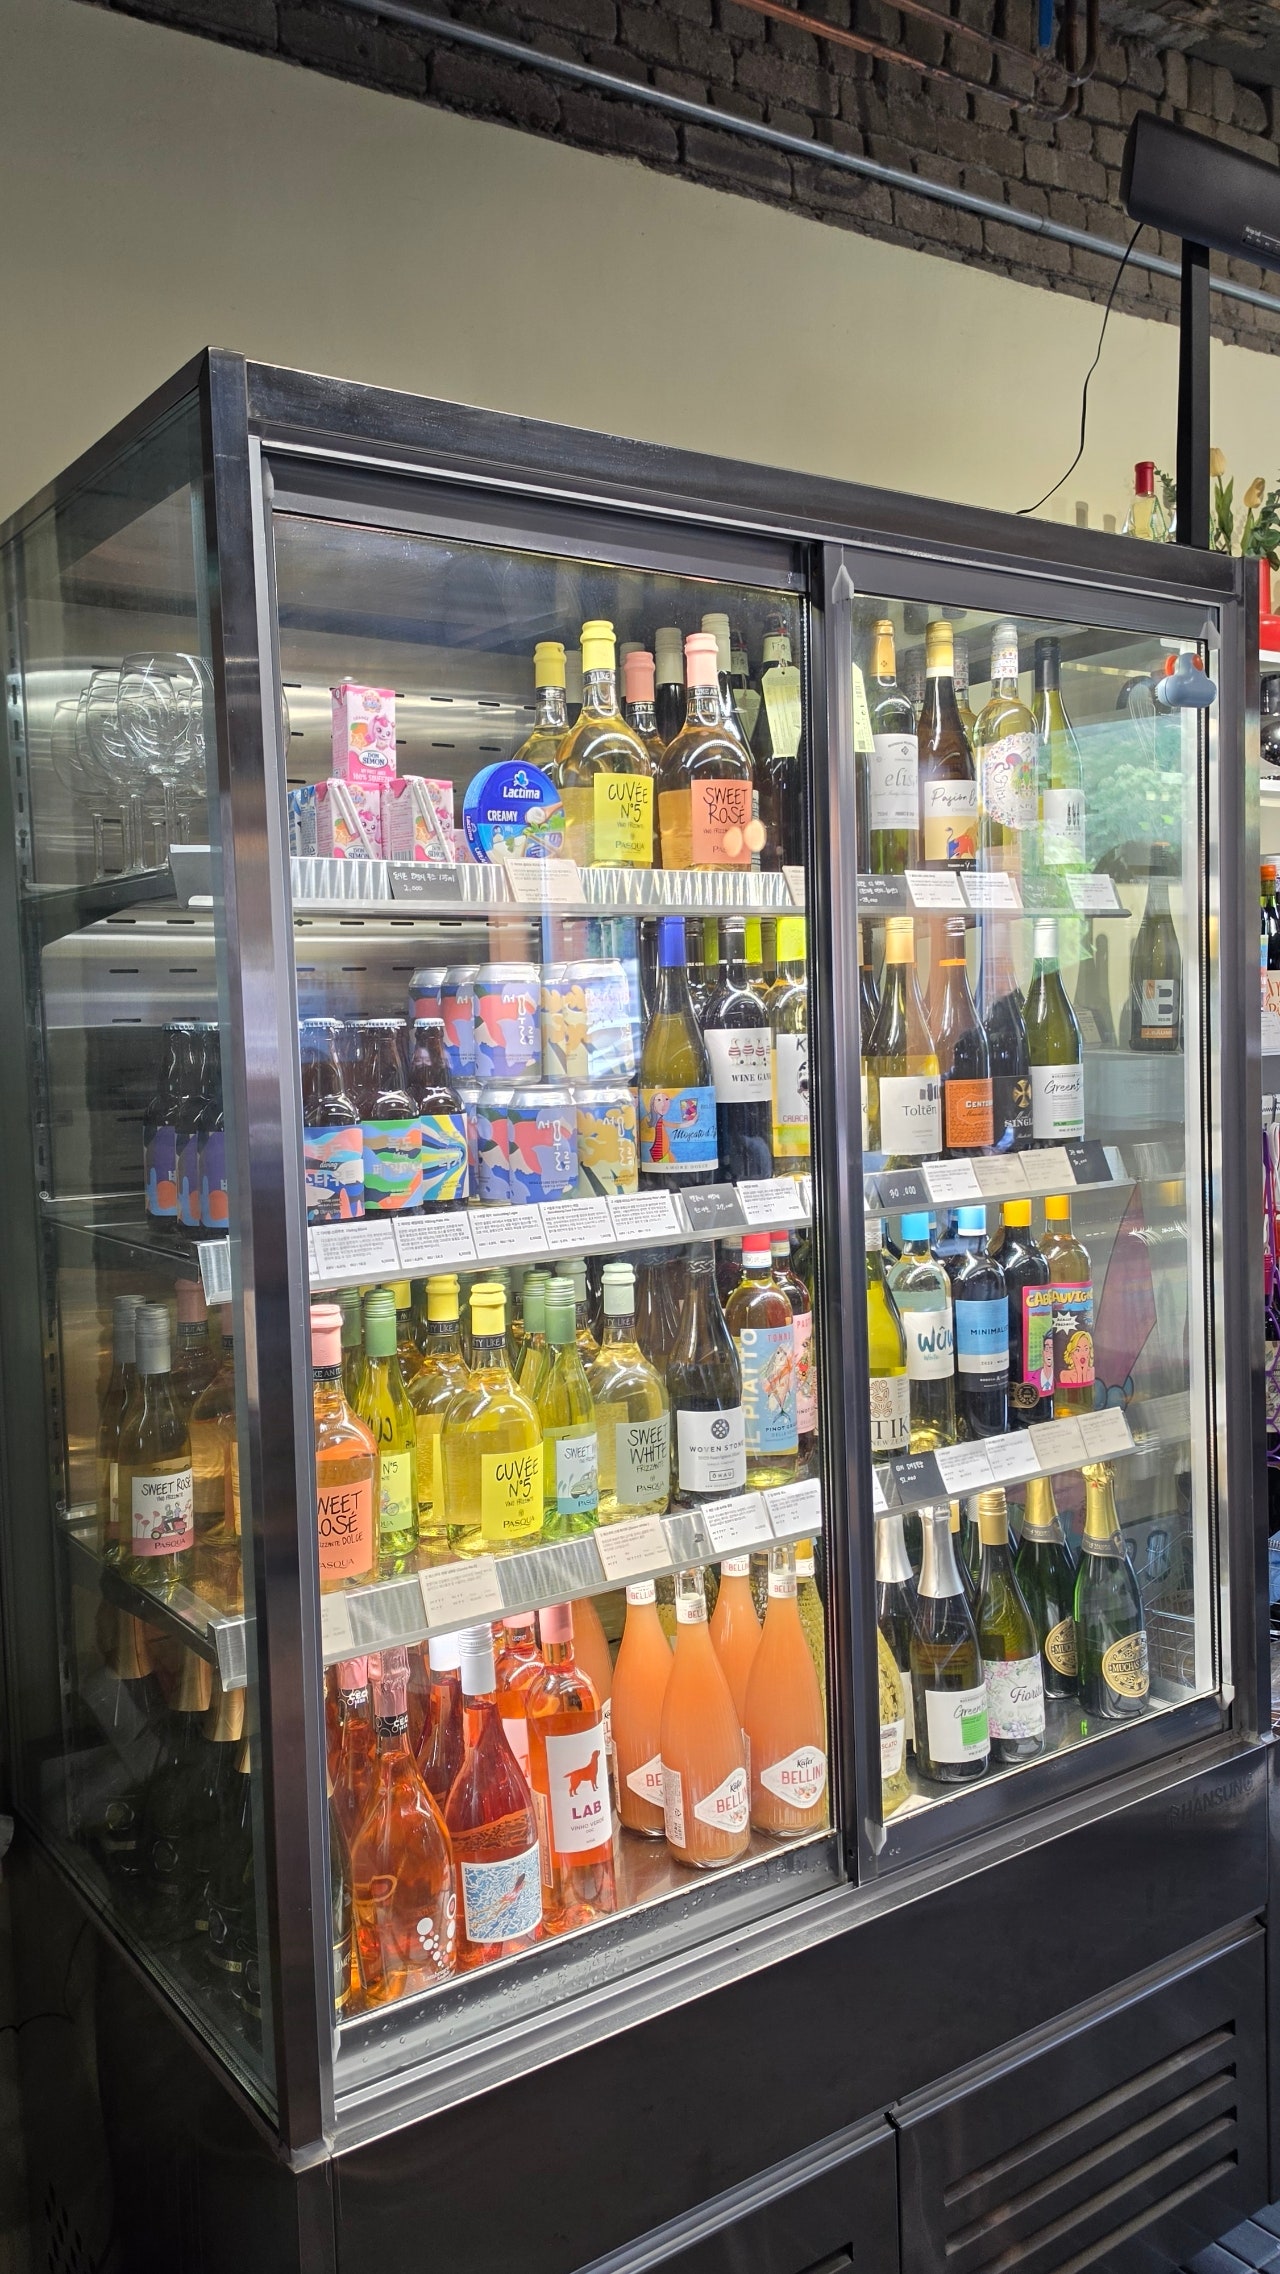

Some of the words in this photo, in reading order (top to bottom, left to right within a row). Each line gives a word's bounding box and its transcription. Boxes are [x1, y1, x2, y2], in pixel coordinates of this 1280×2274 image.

[362, 757, 385, 766] SIMON
[502, 786, 541, 800] Lactima
[607, 781, 649, 805] CUVÉE
[702, 787, 748, 806] SWEET
[487, 810, 518, 822] CREAMY
[708, 804, 746, 825] ROSÉ
[615, 840, 646, 850] PASQUA
[731, 1074, 755, 1083] WINE
[757, 1073, 772, 1083] GAN
[320, 1161, 338, 1170] diving
[627, 1422, 669, 1447] SWEET
[563, 1443, 591, 1460] SWEET
[629, 1442, 669, 1465] WHITE
[689, 1445, 722, 1453] WOVEN
[495, 1457, 539, 1482] CUVÉE
[140, 1481, 173, 1498] SWEET
[175, 1474, 192, 1491] ROSÉ
[508, 1477, 532, 1498] N°5
[636, 1481, 665, 1493] PASQUA
[317, 1510, 359, 1537] OSÉ
[502, 1516, 535, 1529] PASQUA
[154, 1537, 187, 1550] PASQUA
[341, 1533, 364, 1546] DOLCE
[319, 1558, 355, 1570] ASQUA
[880, 1740, 898, 1750] SCATO
[781, 1763, 824, 1785] BELLINI
[571, 1801, 602, 1820] LAB
[570, 1824, 588, 1832] VINHO
[589, 1817, 606, 1829] VERDE
